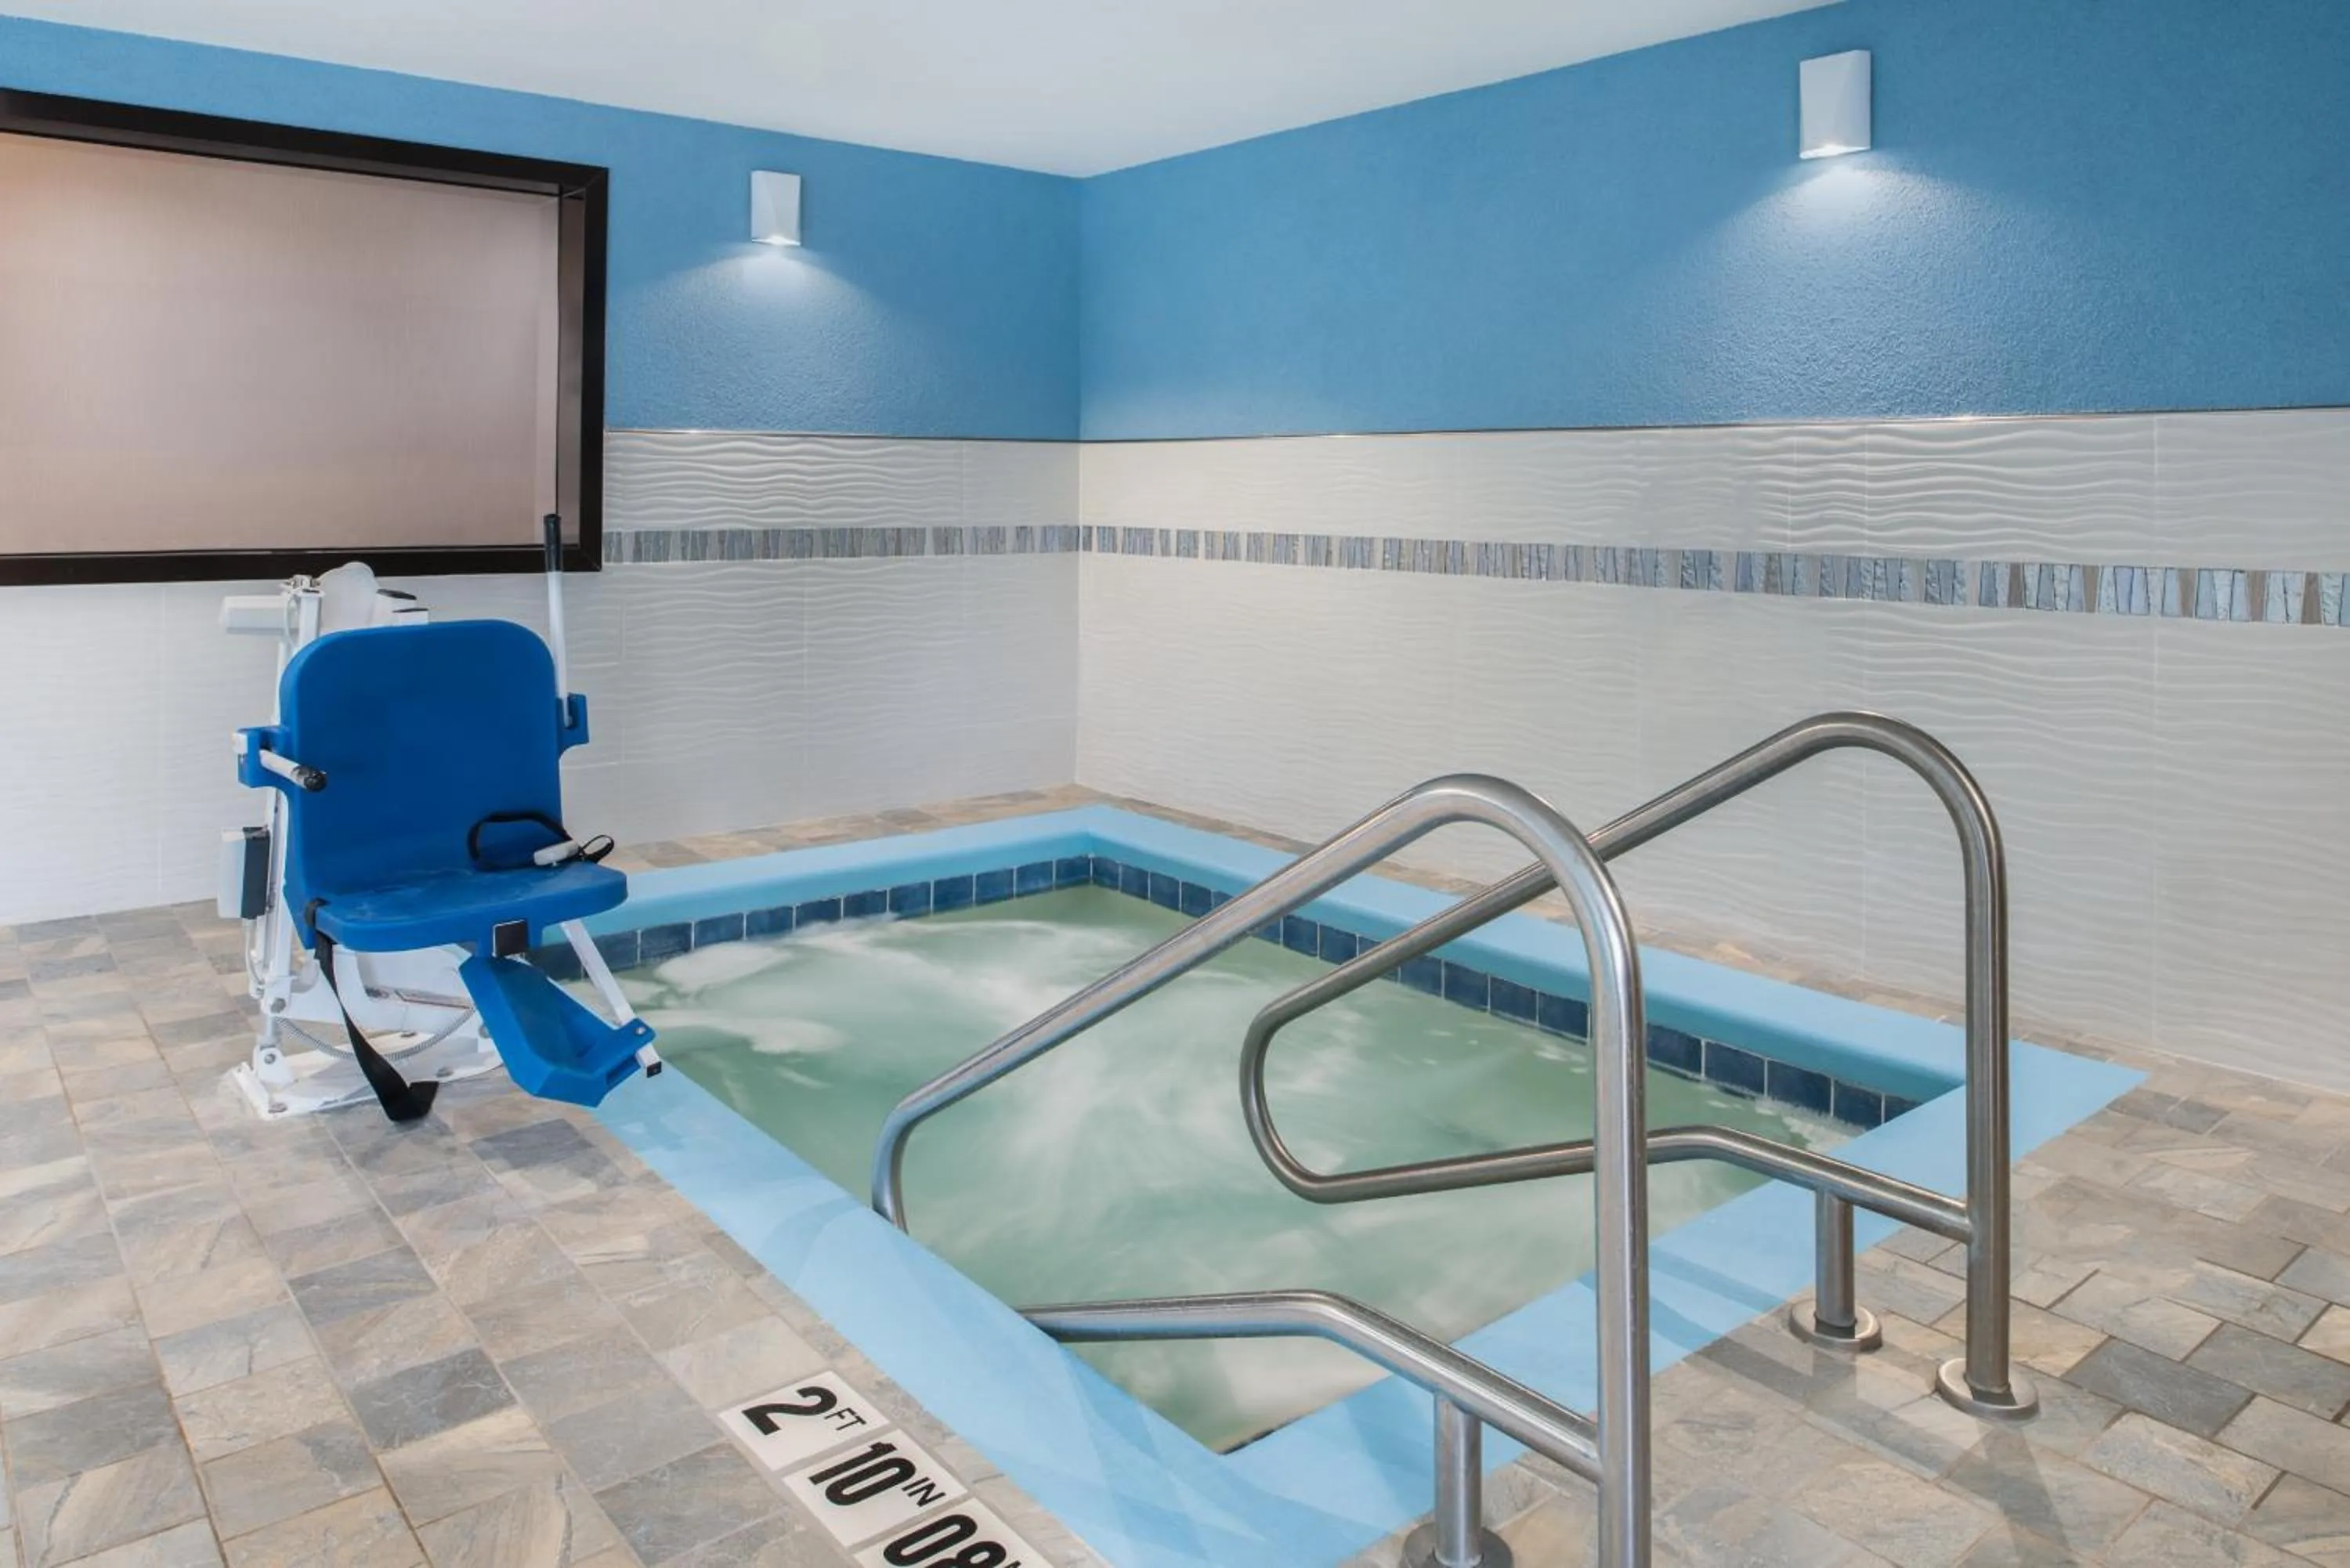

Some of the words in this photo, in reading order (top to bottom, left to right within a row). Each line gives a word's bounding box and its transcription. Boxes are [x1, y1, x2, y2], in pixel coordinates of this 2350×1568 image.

[741, 1386, 837, 1436] 2
[824, 1407, 866, 1431] FT
[808, 1442, 916, 1506] 10
[902, 1476, 946, 1508] IN
